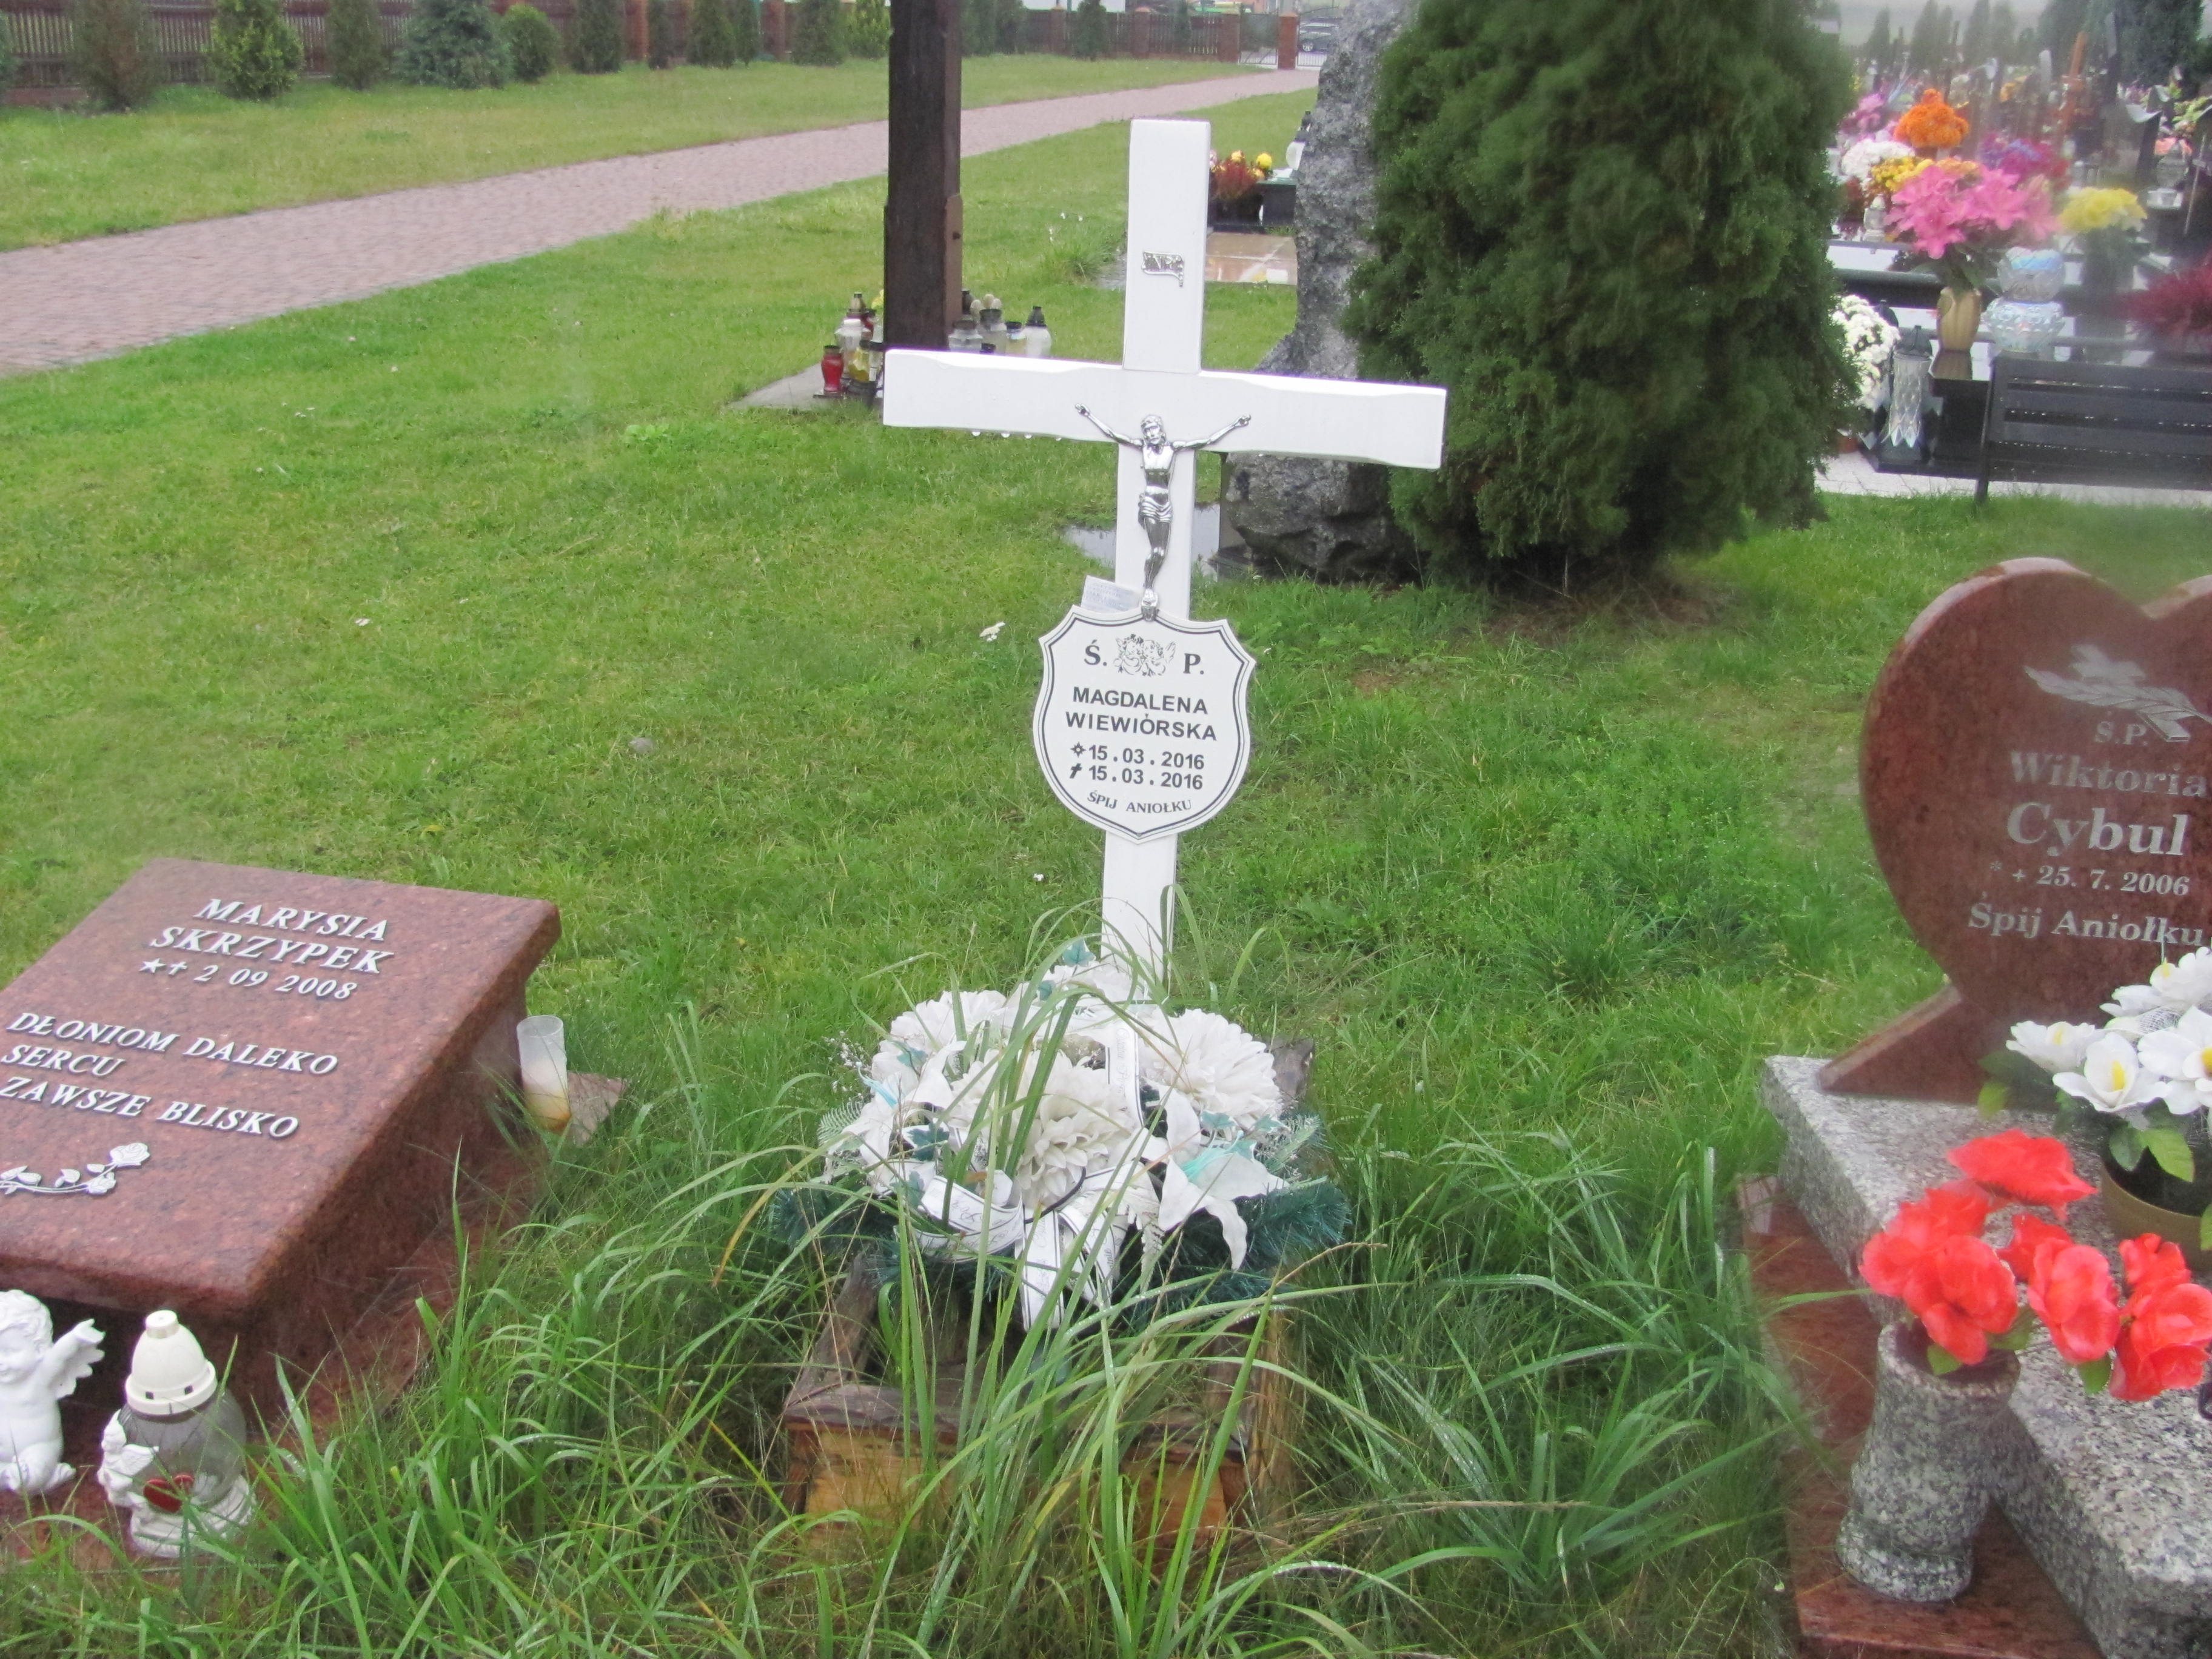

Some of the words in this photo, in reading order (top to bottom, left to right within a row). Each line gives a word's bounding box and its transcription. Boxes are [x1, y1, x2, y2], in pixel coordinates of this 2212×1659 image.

[1073, 686, 1208, 715] MAGDALENA
[1065, 711, 1218, 741] WIEWIÓRSKA
[2010, 749, 2208, 797] Wiktoria
[1087, 789, 1118, 810] ŚPIJ
[1125, 800, 1192, 814] ANIOŁKU
[2006, 801, 2190, 857] Cybul
[2120, 871, 2191, 896] 2006
[192, 898, 388, 941] MARYSIA
[1968, 891, 2043, 939] Śpij
[2051, 910, 2204, 947] Aniołku
[149, 926, 395, 974] SKRZYPEK
[193, 964, 220, 982] 2
[229, 968, 269, 987] 09
[275, 974, 358, 1000] 2008
[1, 1044, 126, 1077] SERCU
[5, 1012, 181, 1053] DŁONIOM
[183, 1036, 339, 1076] DALEKO
[1, 1076, 153, 1117] ZAWSZE
[156, 1101, 300, 1139] BLISKO
